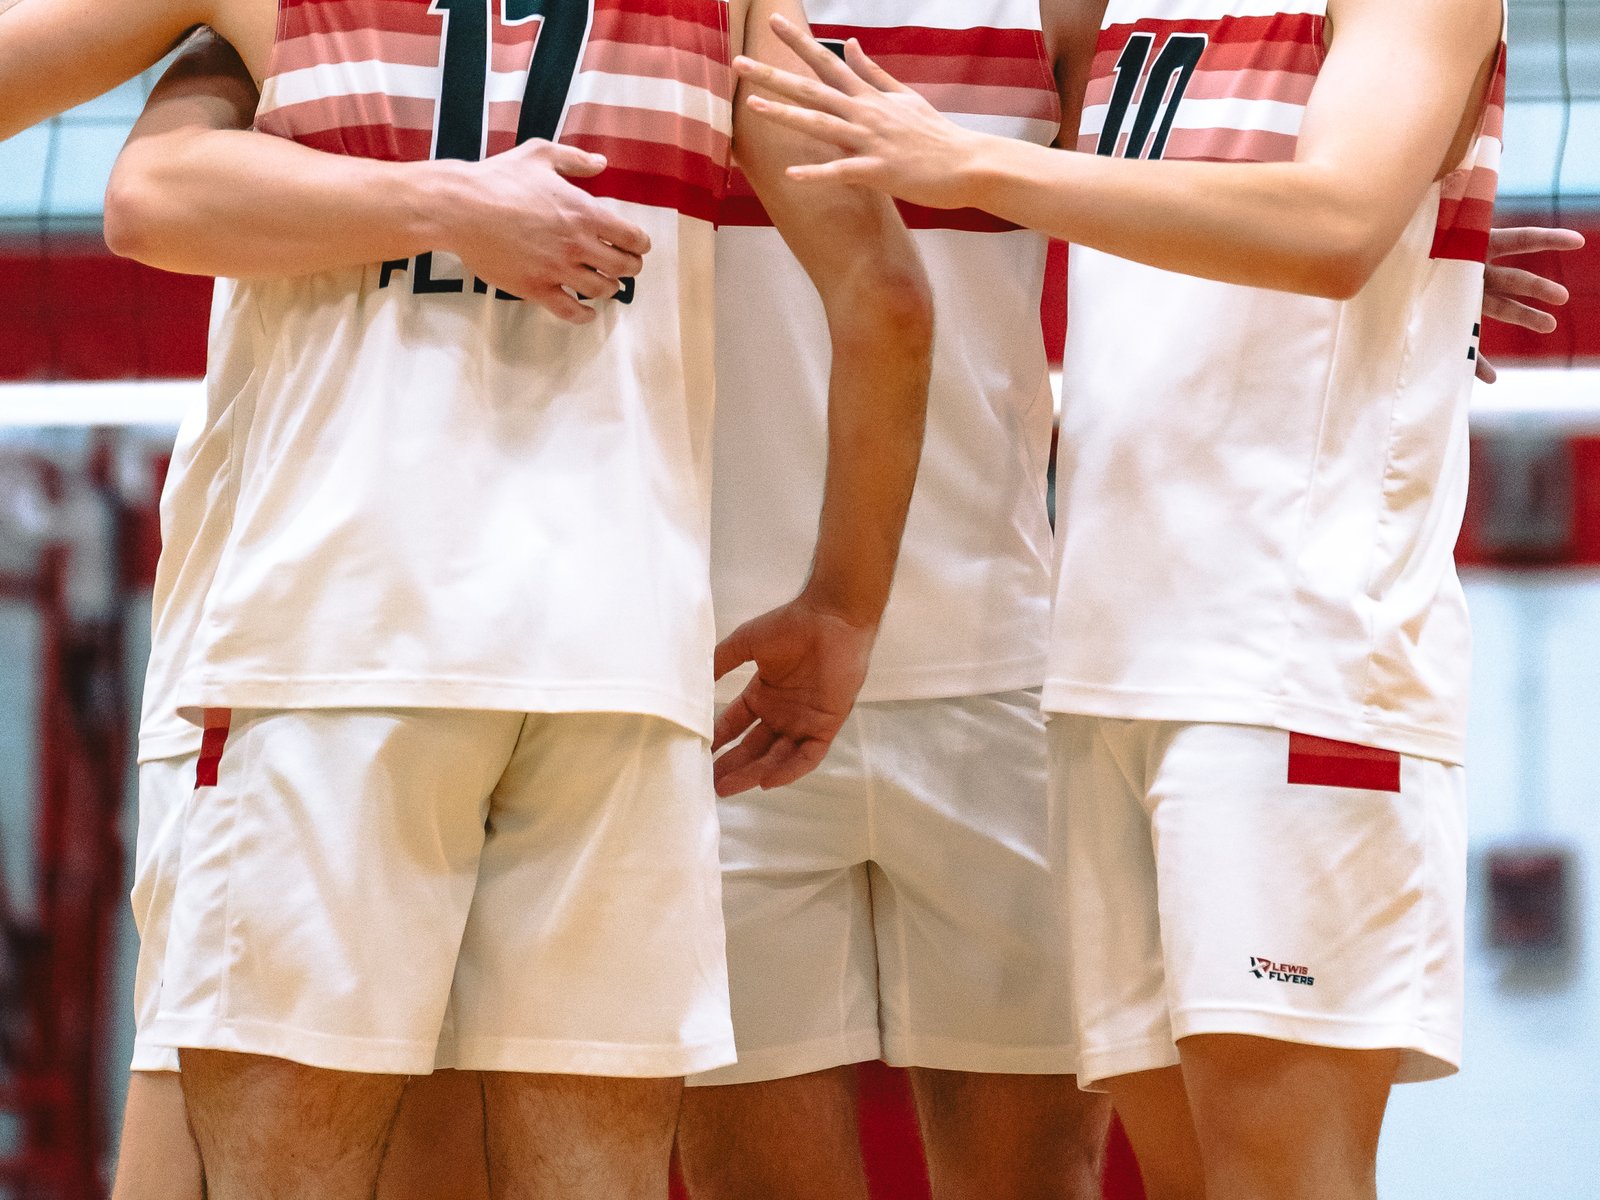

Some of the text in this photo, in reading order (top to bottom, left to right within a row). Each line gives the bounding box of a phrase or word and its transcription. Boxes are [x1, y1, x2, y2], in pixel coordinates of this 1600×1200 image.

[1096, 33, 1208, 160] 10
[1272, 962, 1309, 975] LEWIS
[1269, 971, 1315, 986] FLYERS
